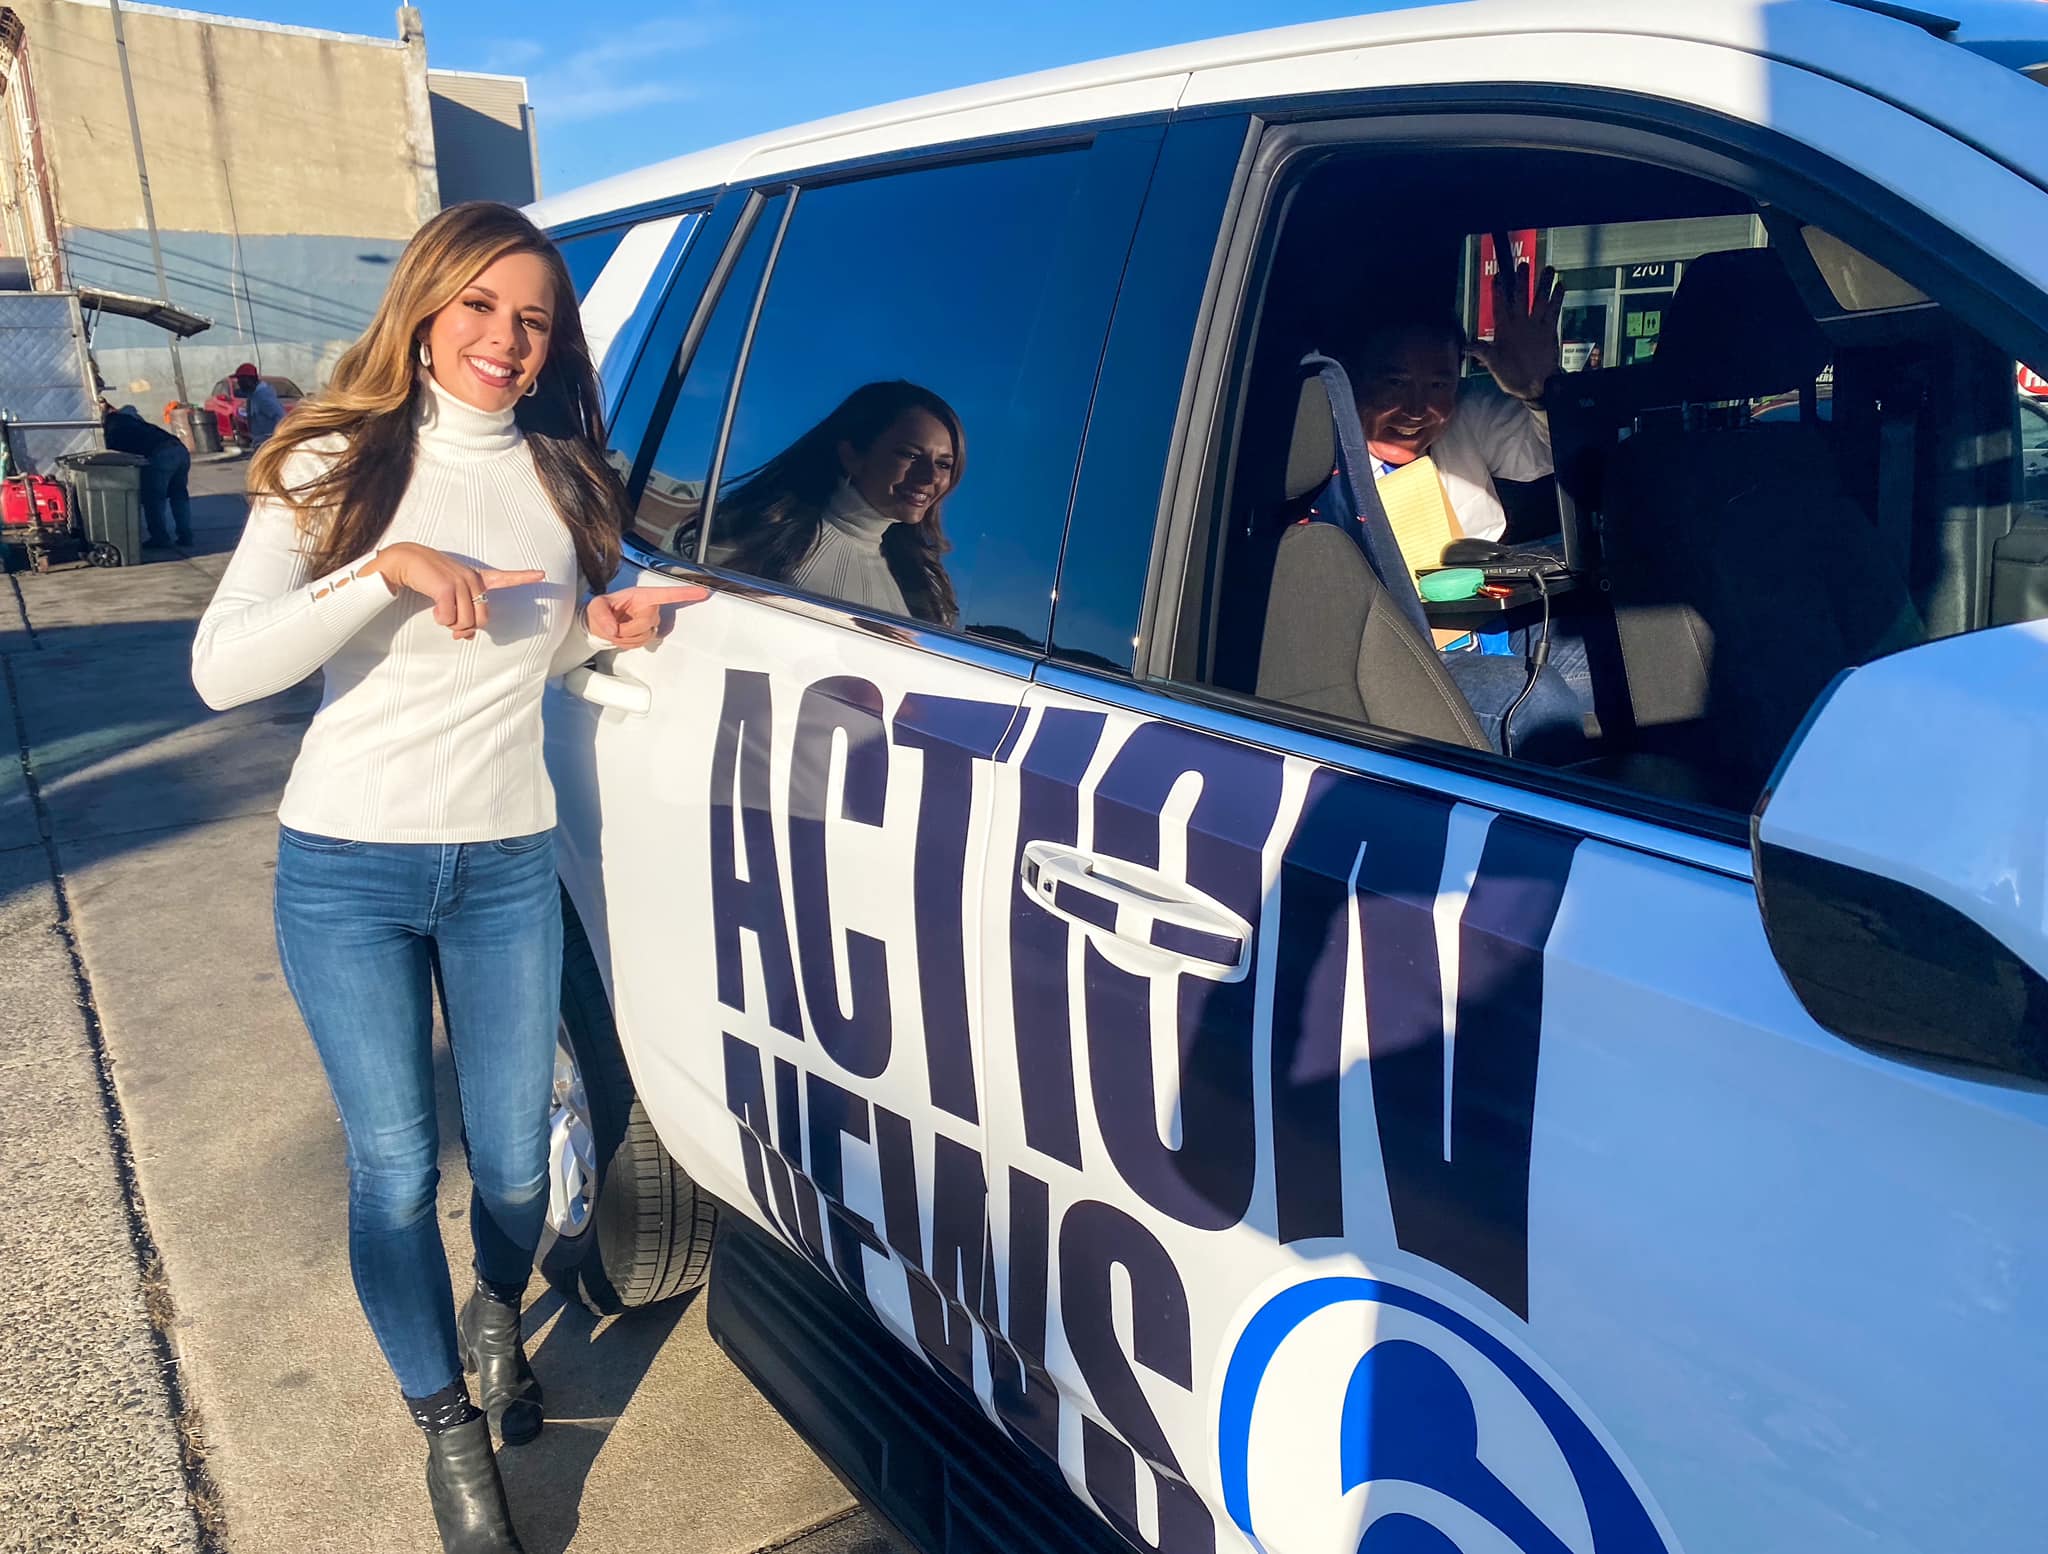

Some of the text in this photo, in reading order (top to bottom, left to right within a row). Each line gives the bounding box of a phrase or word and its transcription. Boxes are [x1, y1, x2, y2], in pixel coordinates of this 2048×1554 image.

[1632, 264, 1664, 277] 2701
[709, 668, 1587, 1324] ACTION
[721, 1029, 1216, 1554] NEWS
